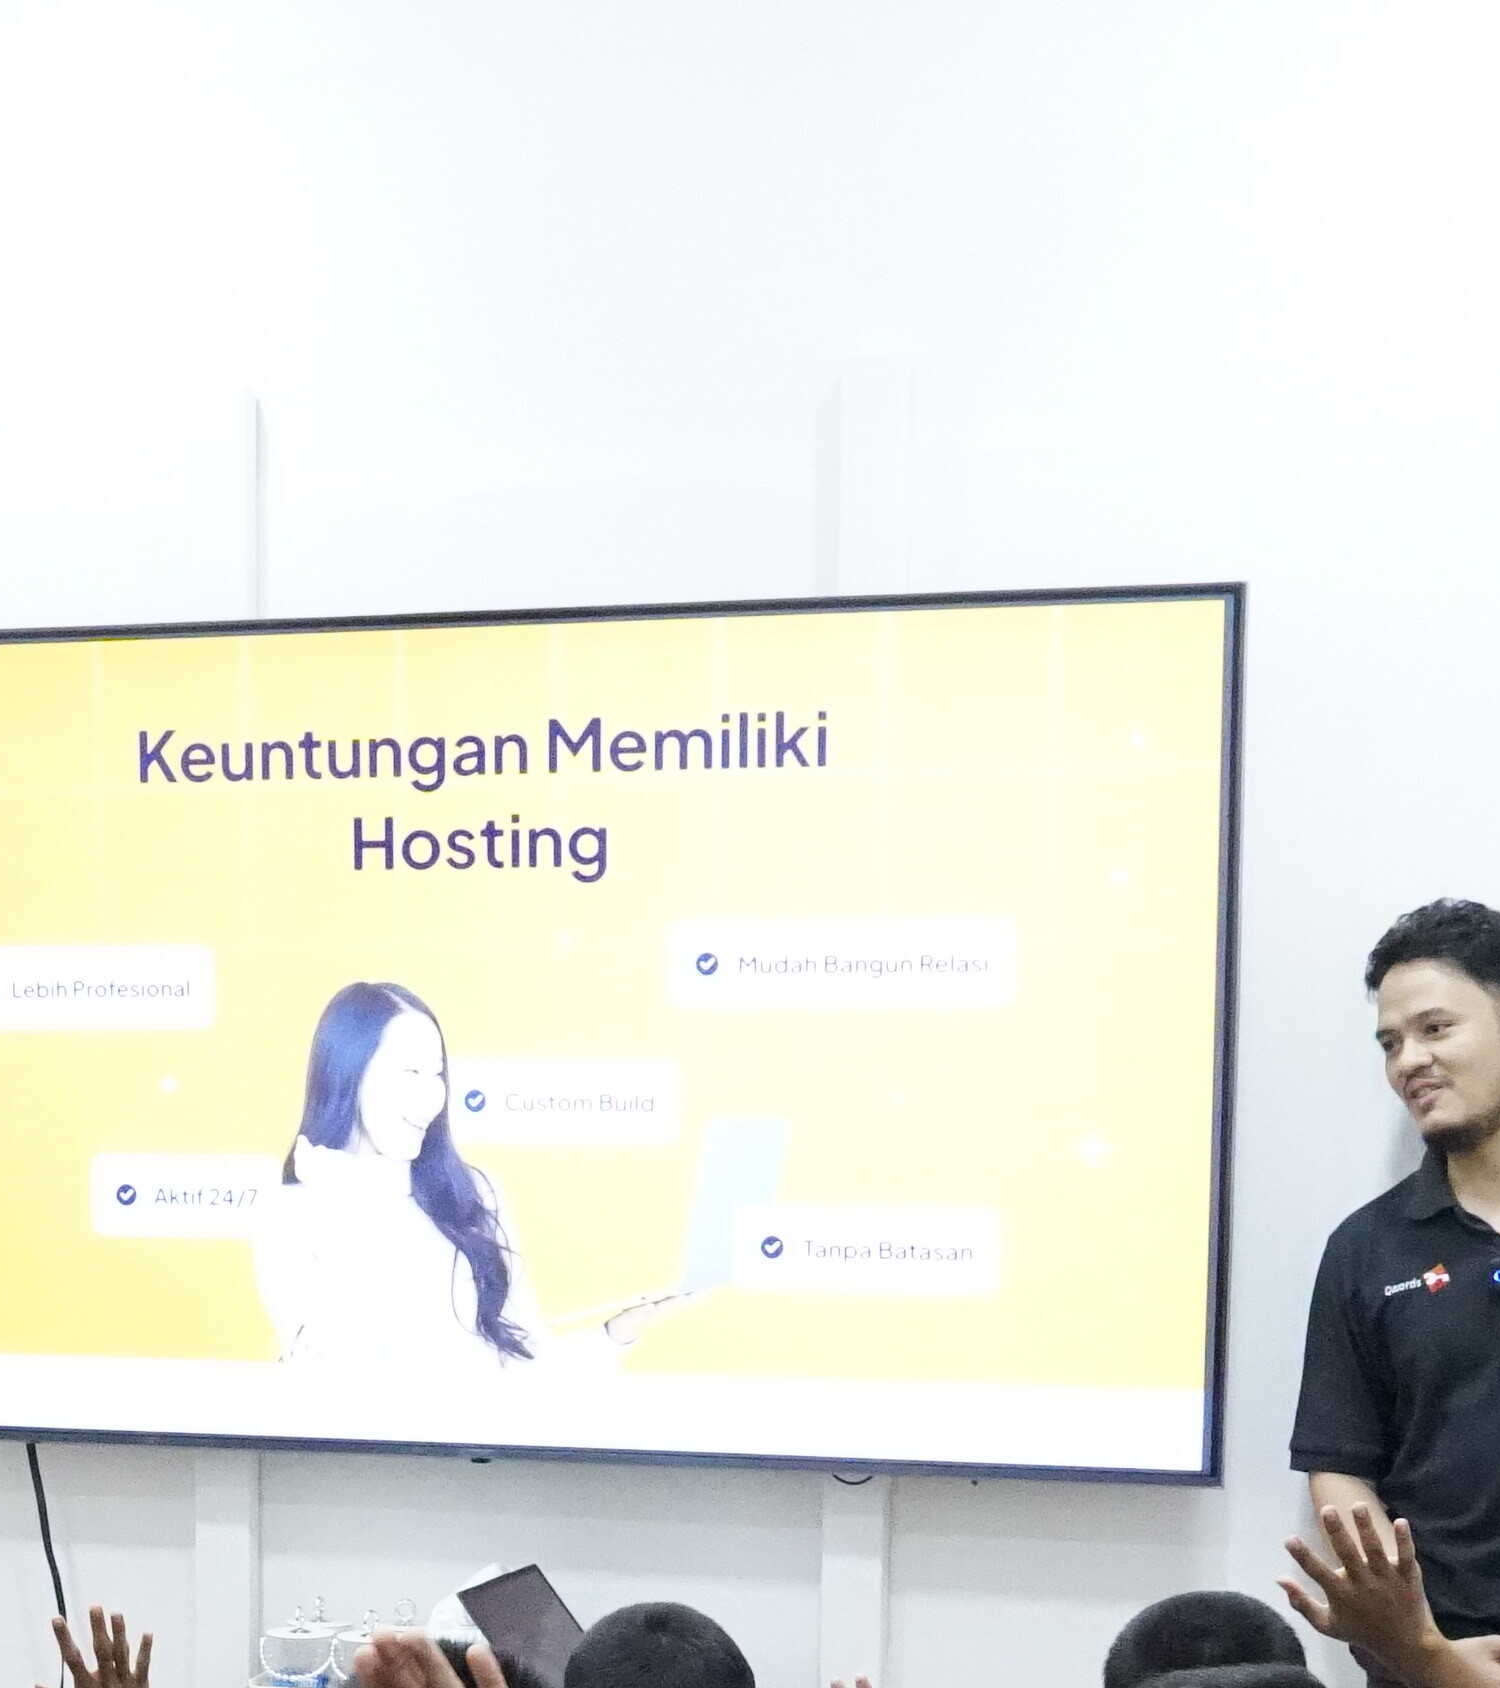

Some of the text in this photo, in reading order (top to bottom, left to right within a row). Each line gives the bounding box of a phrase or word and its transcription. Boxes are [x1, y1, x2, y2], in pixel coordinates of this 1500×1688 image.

[137, 710, 828, 793] Keuntungan Memiliki
[353, 814, 608, 884] Hosting
[738, 952, 989, 979] Mudah Bangun Relasi
[12, 979, 190, 999] Lebih Profesional
[505, 1092, 655, 1113] Custom Build
[154, 1187, 258, 1208] Aktif 24/7
[804, 1240, 974, 1262] Tanpa Batasan
